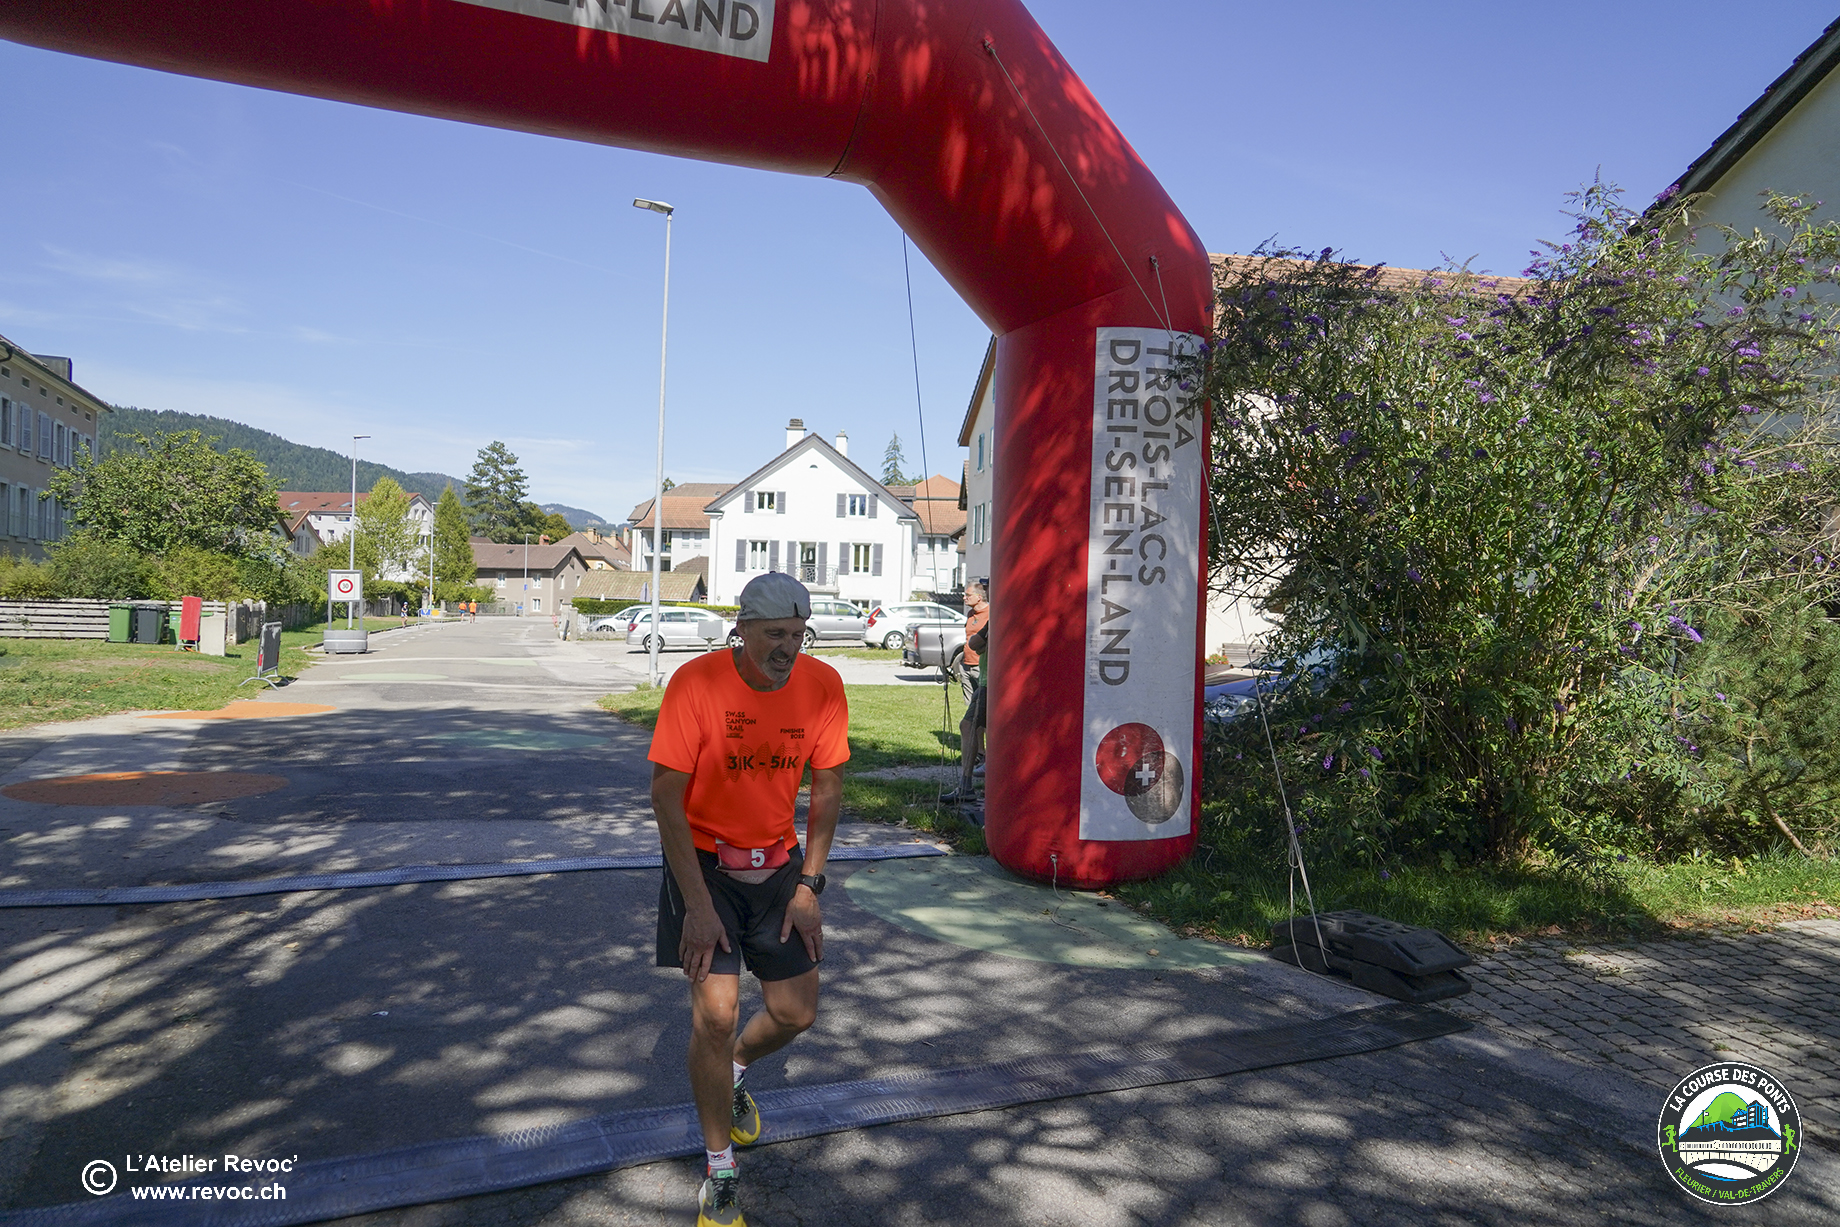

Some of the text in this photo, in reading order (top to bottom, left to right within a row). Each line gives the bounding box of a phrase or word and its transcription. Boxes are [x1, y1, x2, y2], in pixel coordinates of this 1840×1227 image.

[544, 0, 760, 41] -LAND
[1138, 341, 1175, 586] TROIS-LACS
[1098, 339, 1141, 686] DREI-SEEN-LAND
[726, 724, 744, 732] TRAIL
[751, 848, 765, 868] 5
